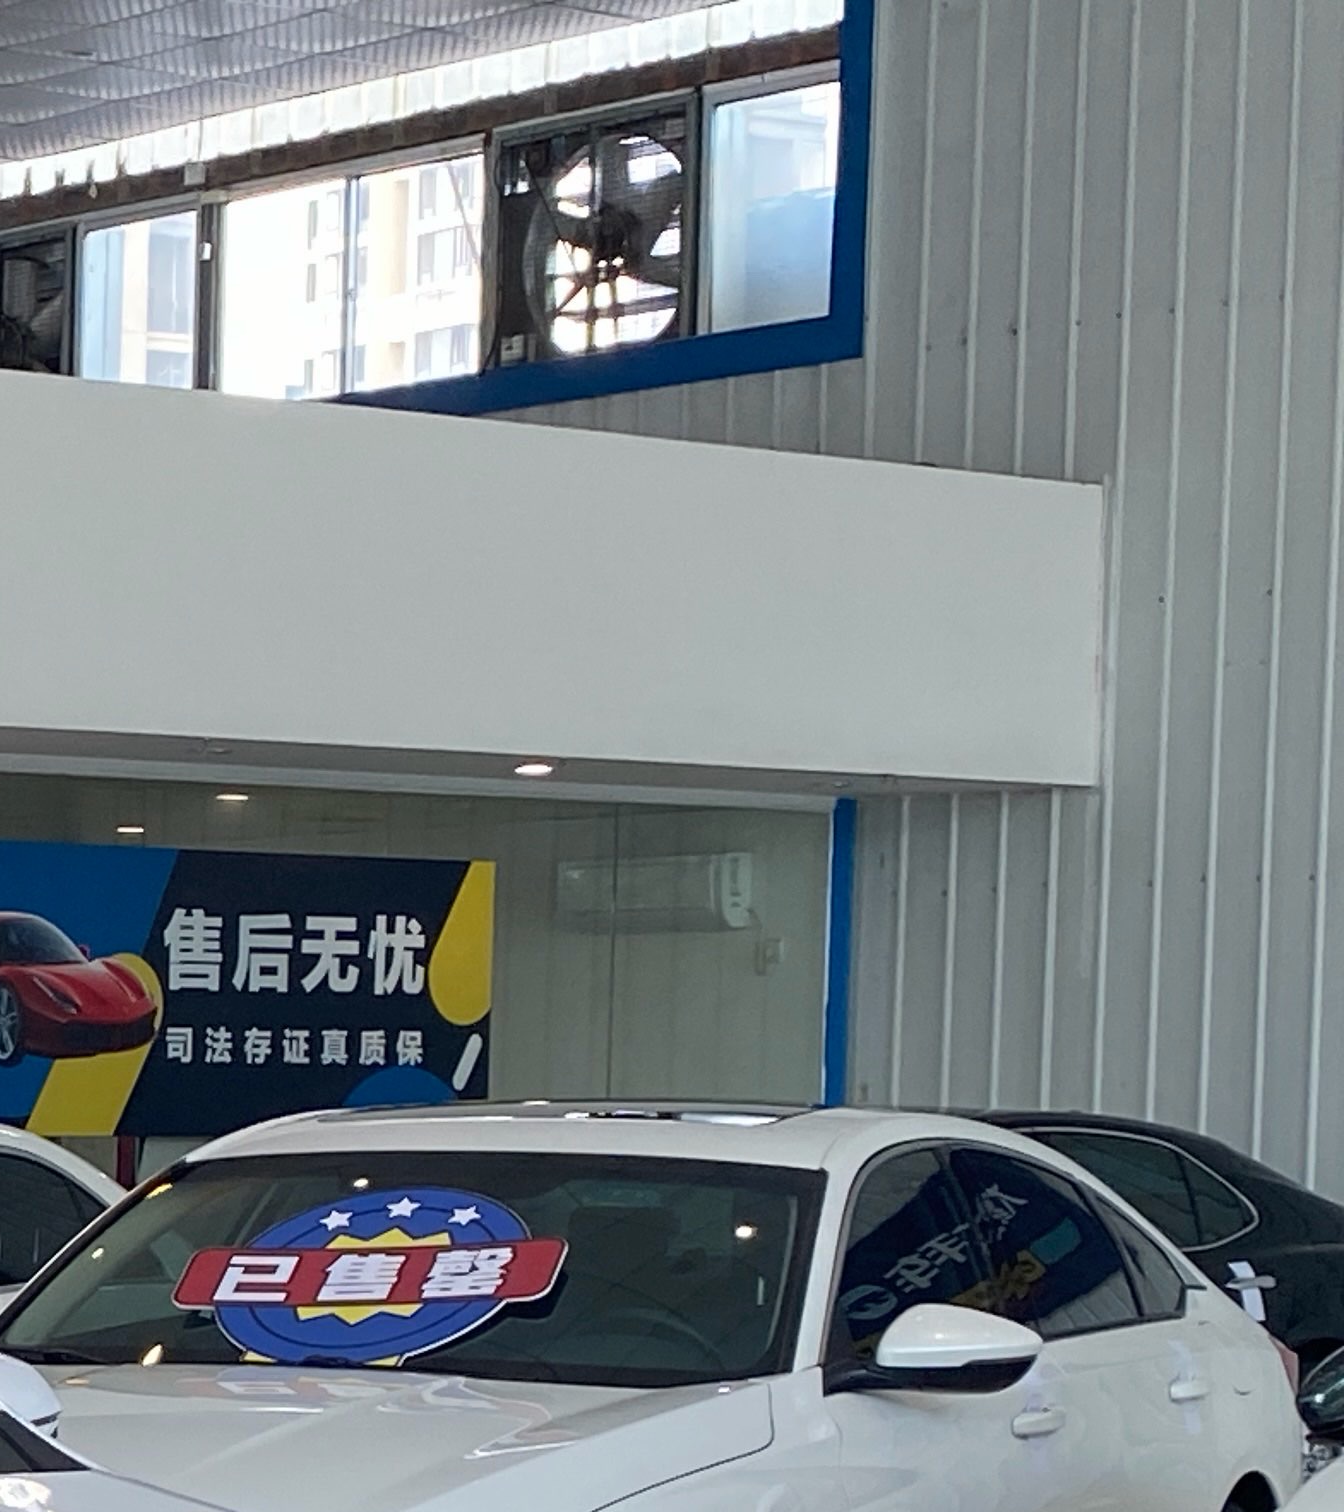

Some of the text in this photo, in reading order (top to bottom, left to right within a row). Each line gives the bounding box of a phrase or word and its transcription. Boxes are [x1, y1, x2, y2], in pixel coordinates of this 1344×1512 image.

[163, 906, 427, 996] 售后无忧
[166, 1026, 424, 1067] 司法存证真质保
[214, 1246, 514, 1303] 已售罄
